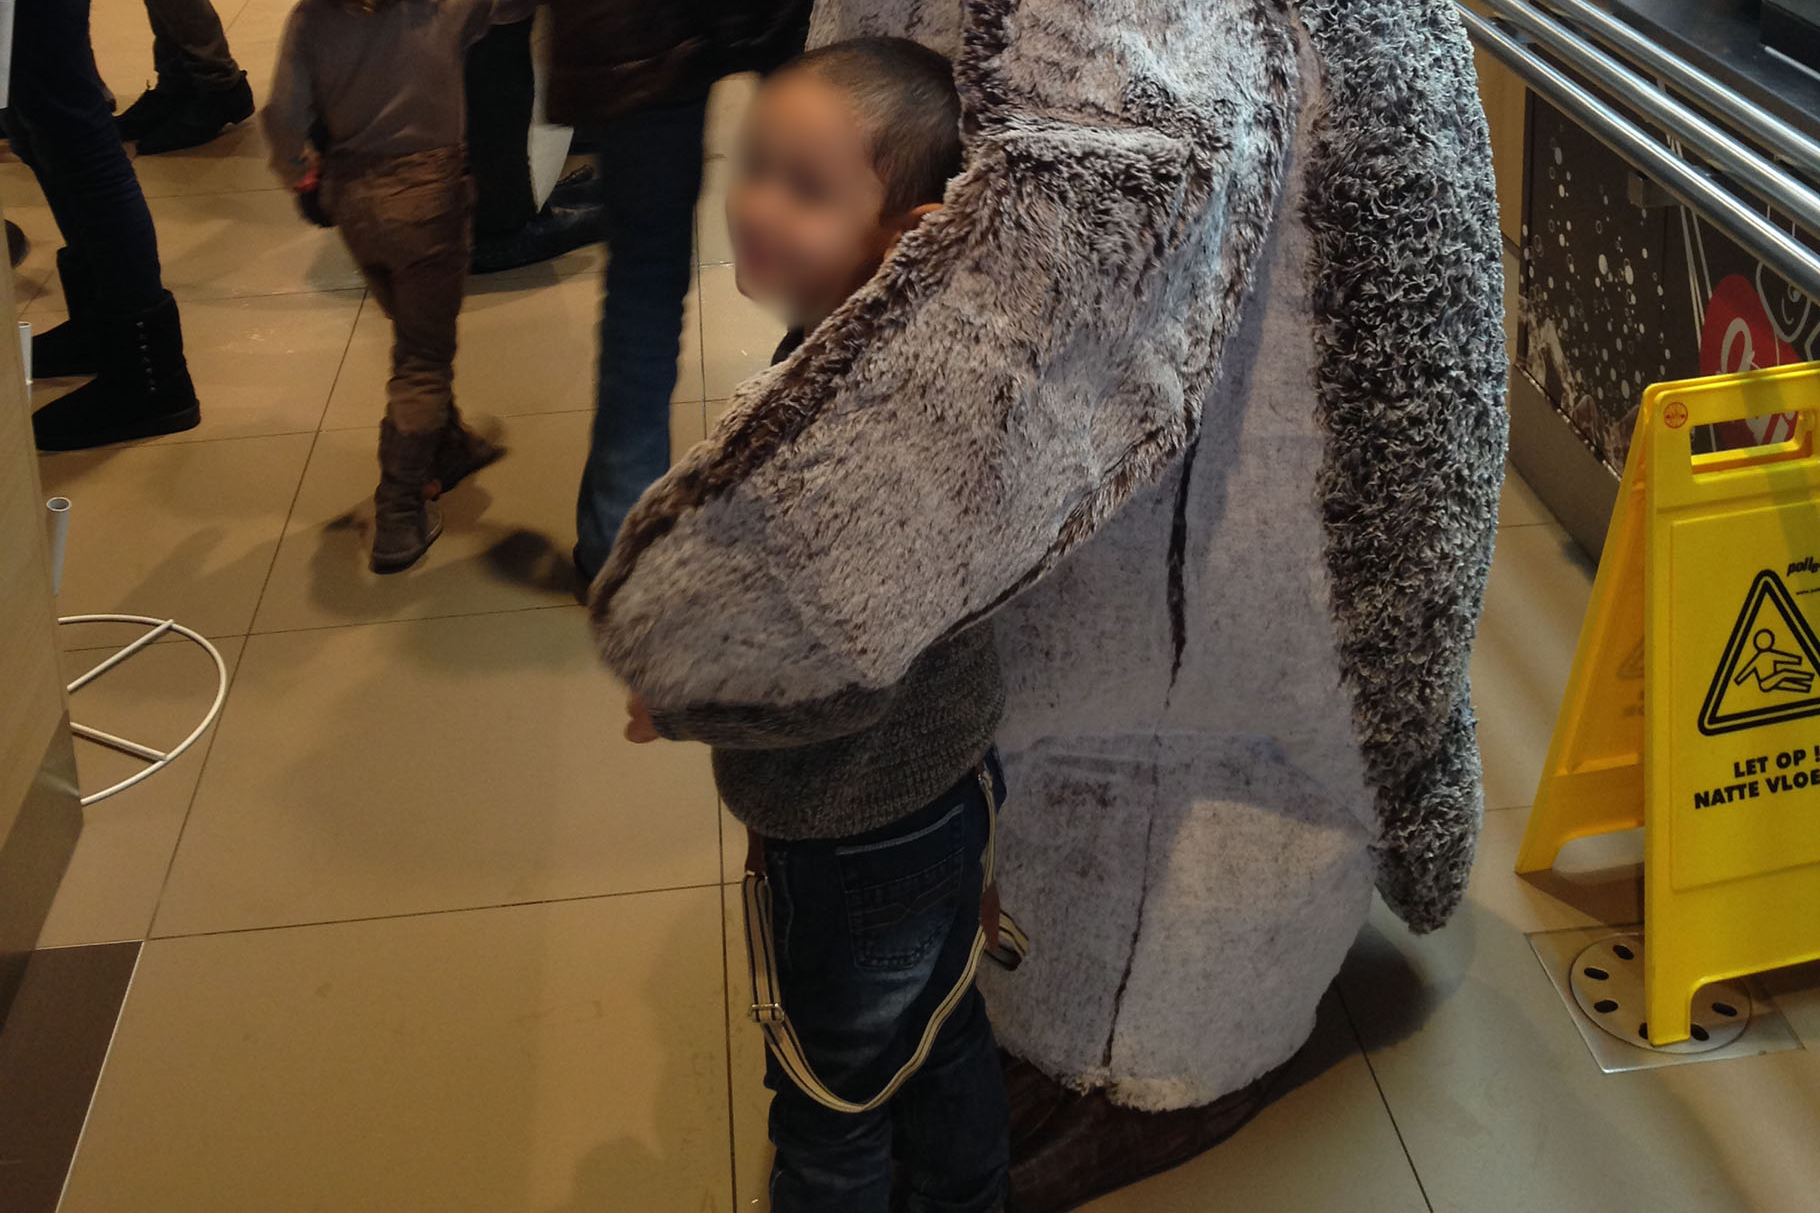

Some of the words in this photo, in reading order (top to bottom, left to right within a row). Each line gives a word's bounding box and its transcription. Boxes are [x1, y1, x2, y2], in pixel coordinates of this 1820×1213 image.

[1733, 755, 1769, 778] LET
[1776, 749, 1807, 769] OP
[1694, 781, 1760, 809] NATTE
